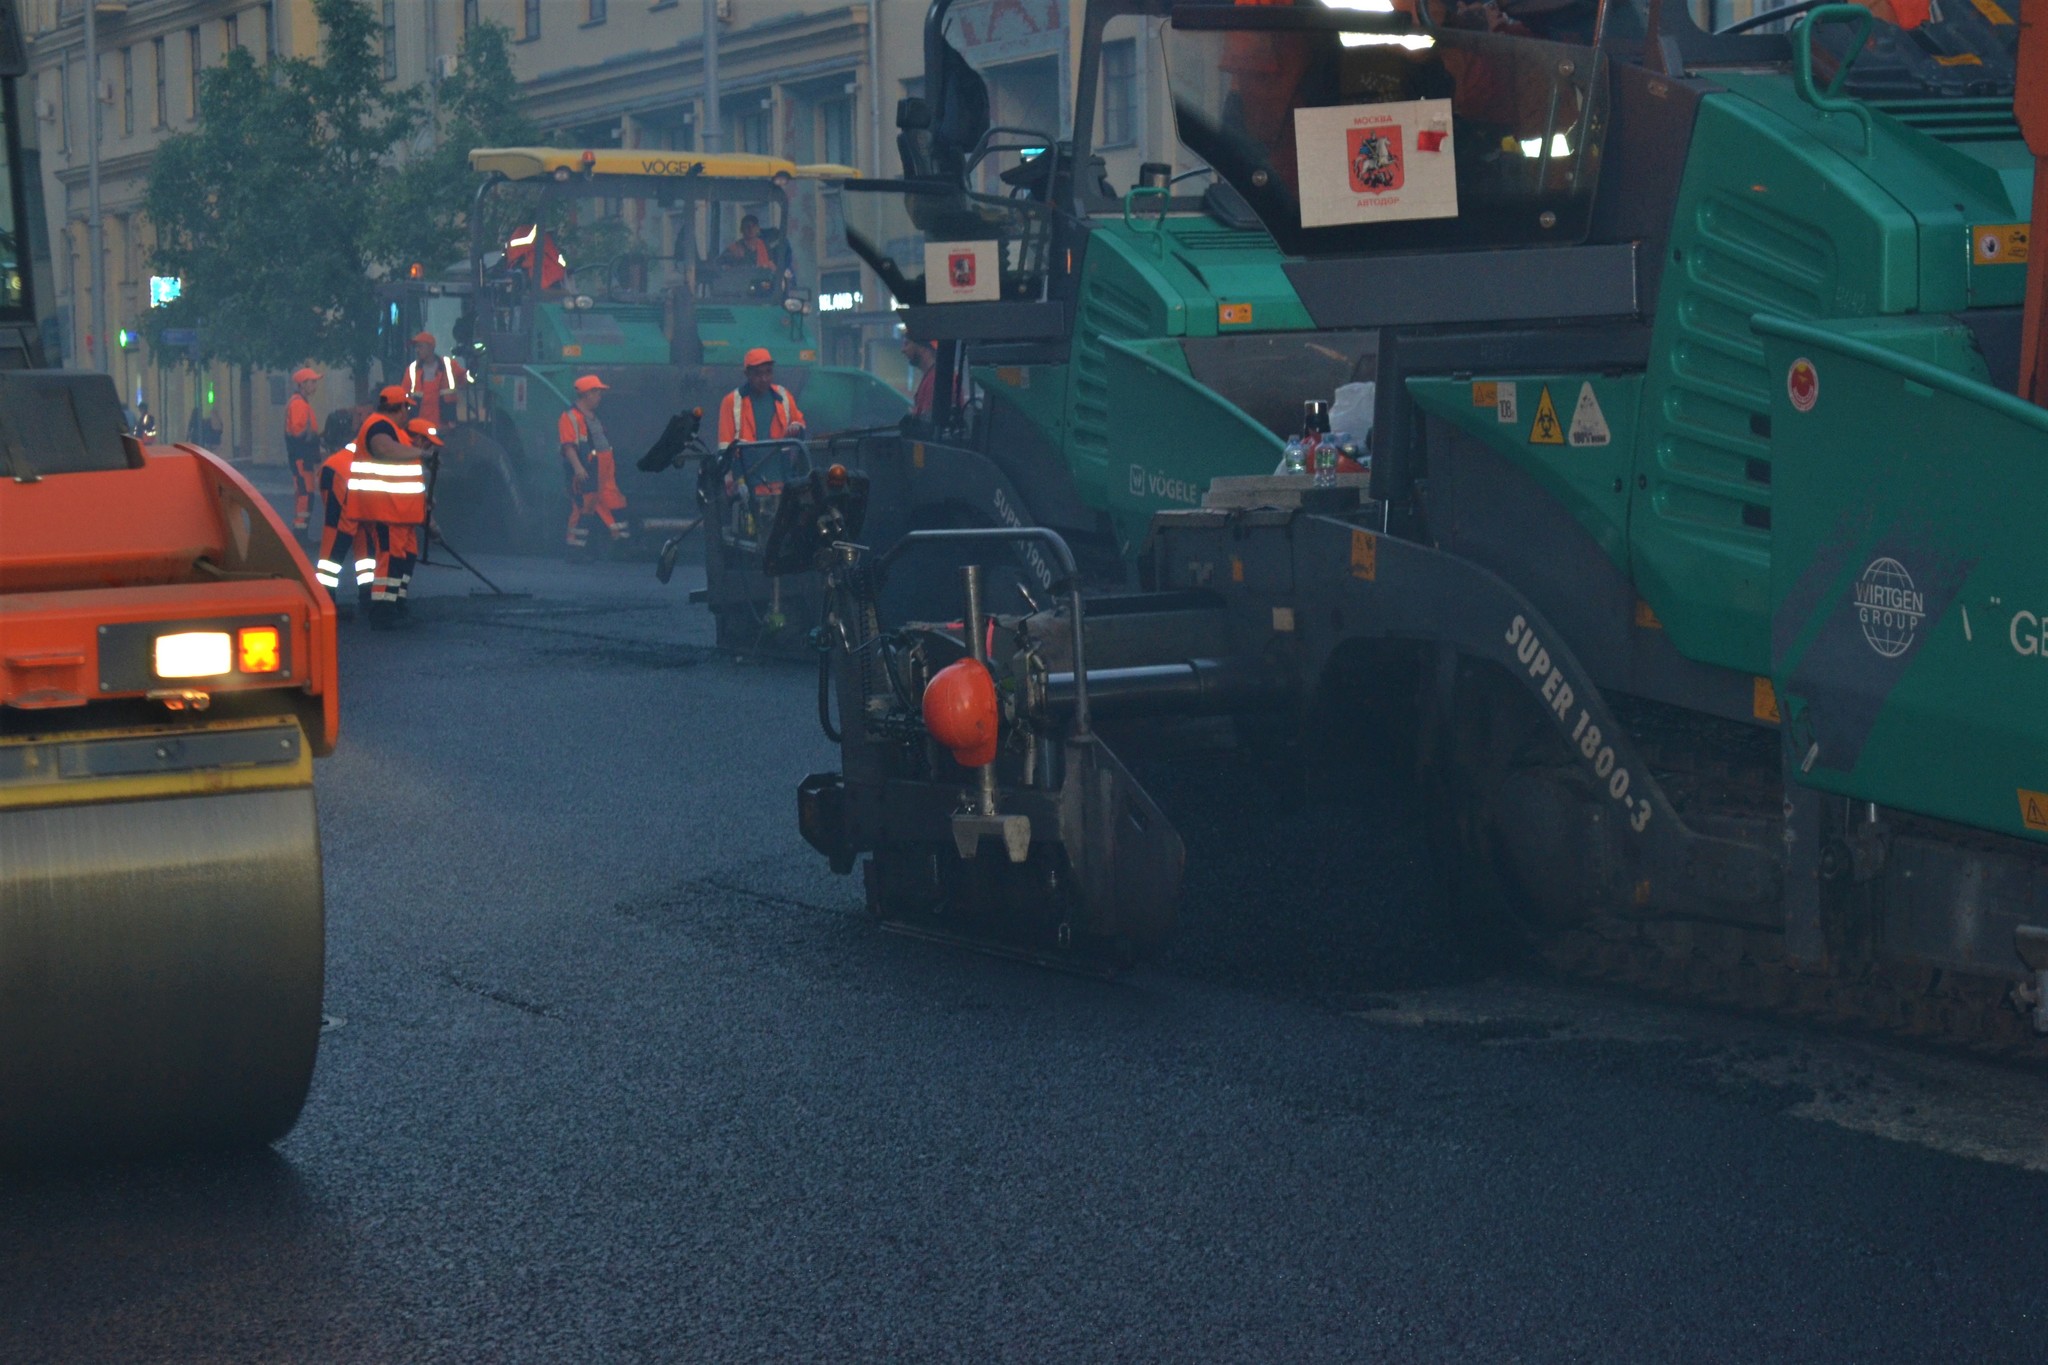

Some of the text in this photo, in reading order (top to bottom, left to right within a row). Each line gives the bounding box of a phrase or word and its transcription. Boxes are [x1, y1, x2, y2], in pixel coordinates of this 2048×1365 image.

[1353, 114, 1393, 126] МОСКВА
[641, 158, 706, 174] VÖGE
[1357, 197, 1401, 208] АВТОДОР
[1148, 469, 1197, 504] VÖGELE
[1026, 541, 1051, 590] 1900
[1856, 582, 1923, 612] WIRTGEN
[1859, 607, 1918, 631] GROUP
[1504, 614, 1652, 833] SUPER 1800-3
